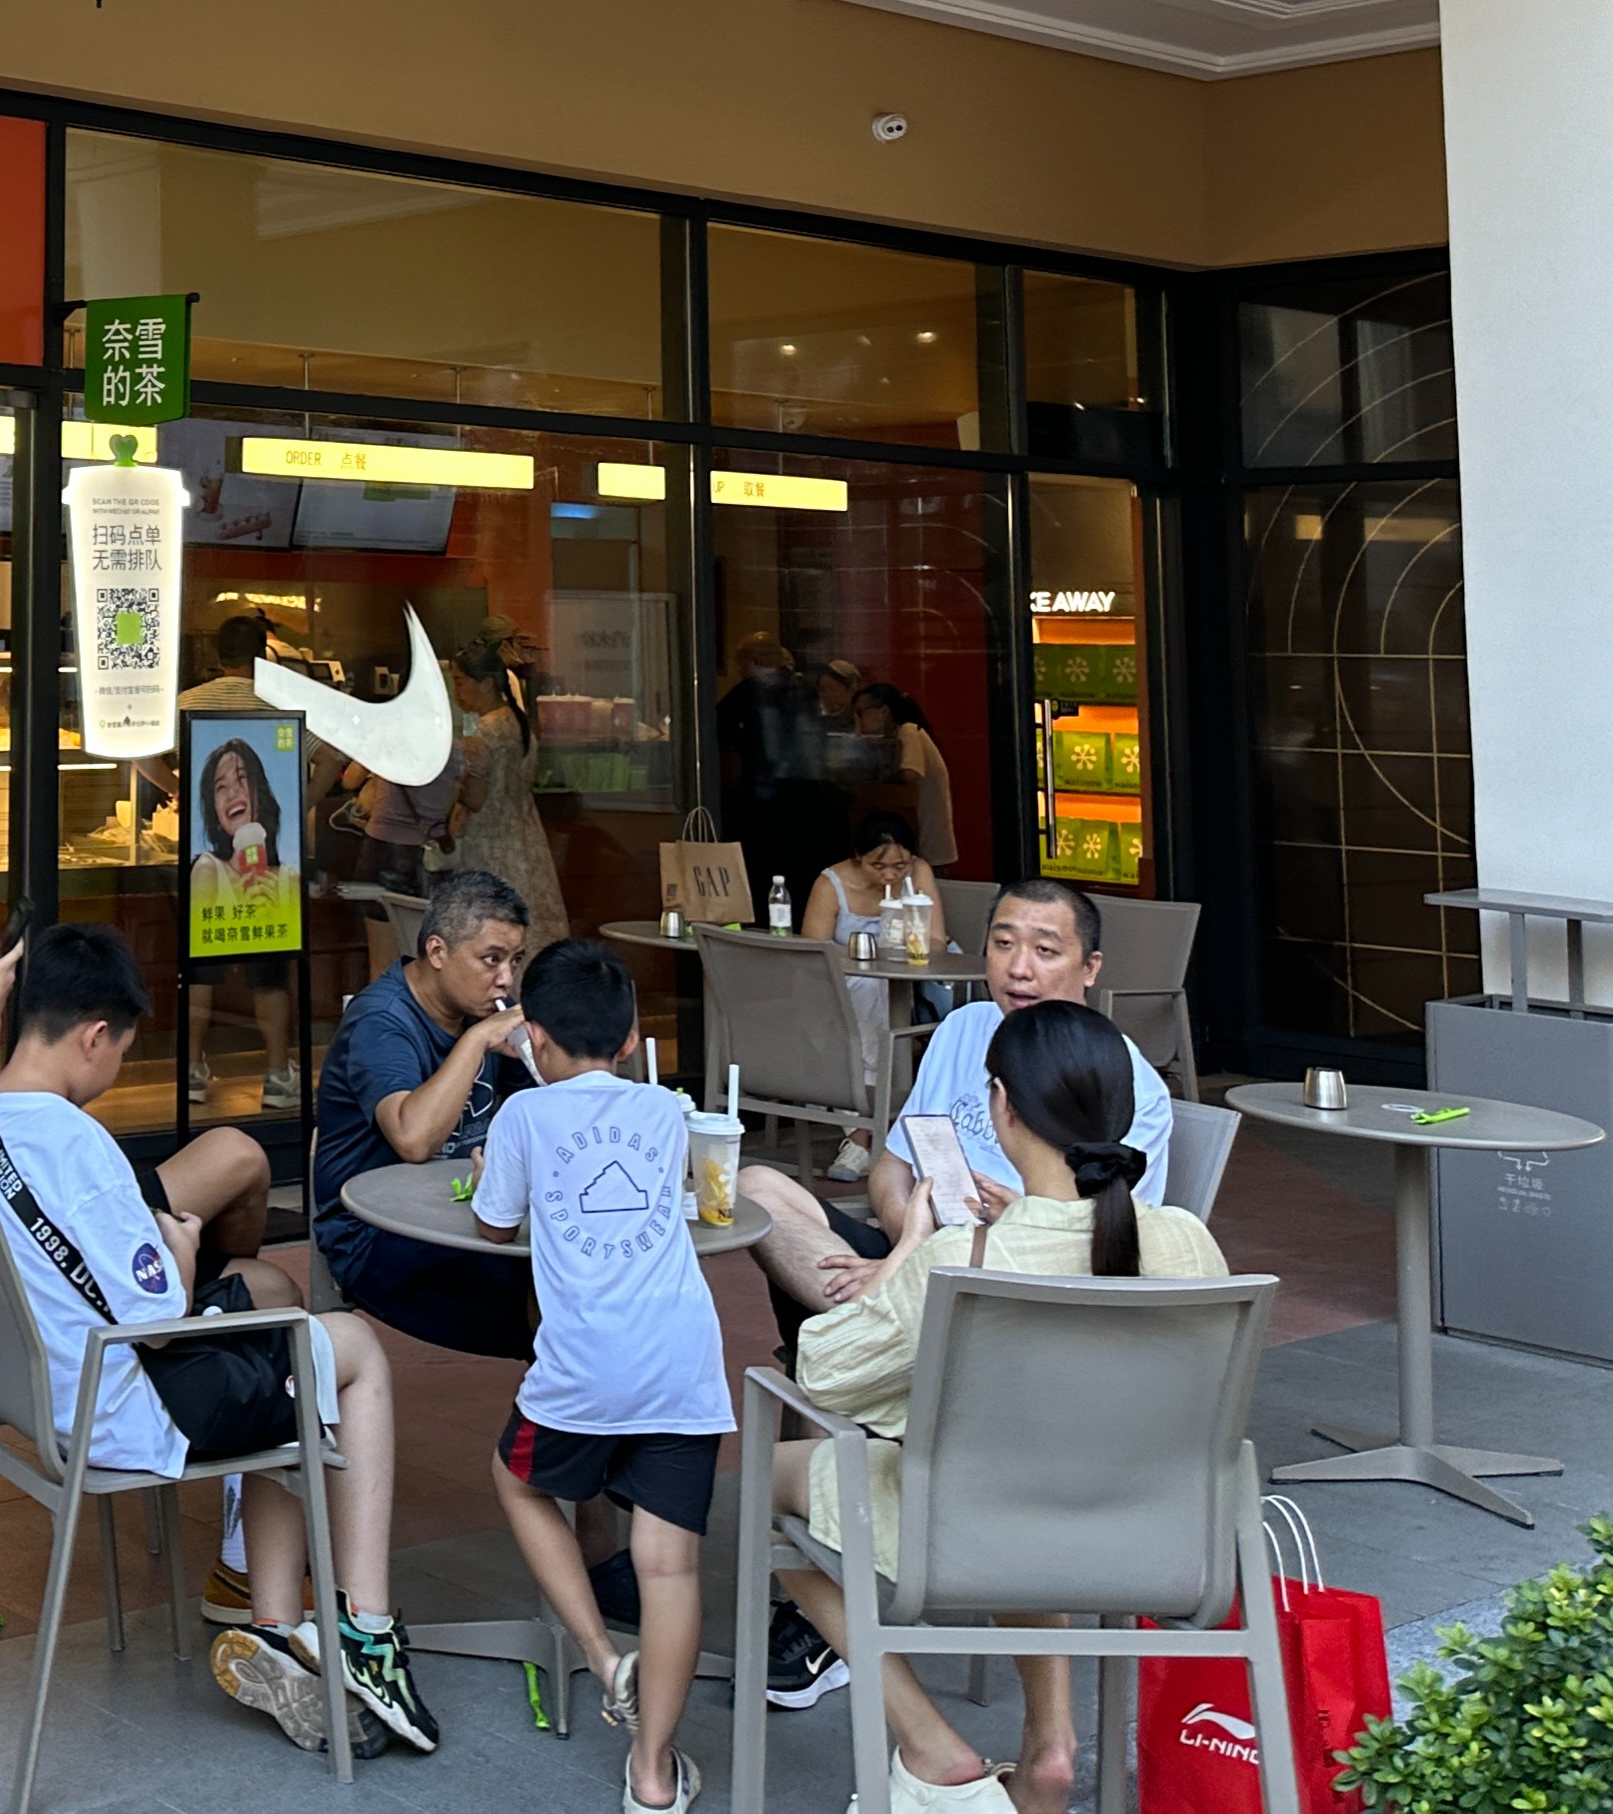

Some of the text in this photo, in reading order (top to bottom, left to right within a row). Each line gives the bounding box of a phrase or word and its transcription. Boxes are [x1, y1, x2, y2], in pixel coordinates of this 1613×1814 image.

[102, 318, 166, 361] 奈雪
[102, 363, 166, 407] 的茶
[286, 450, 367, 471] ORDER 点餐
[92, 523, 161, 546] 扫码点单
[92, 548, 163, 571] 无需排队
[1052, 591, 1116, 612] AWAY
[693, 866, 730, 897] GAP
[201, 904, 257, 922] 鲜果 好茶
[201, 923, 289, 944] 就喝奈雪鲜果茶
[555, 1126, 658, 1164] ADIDAS
